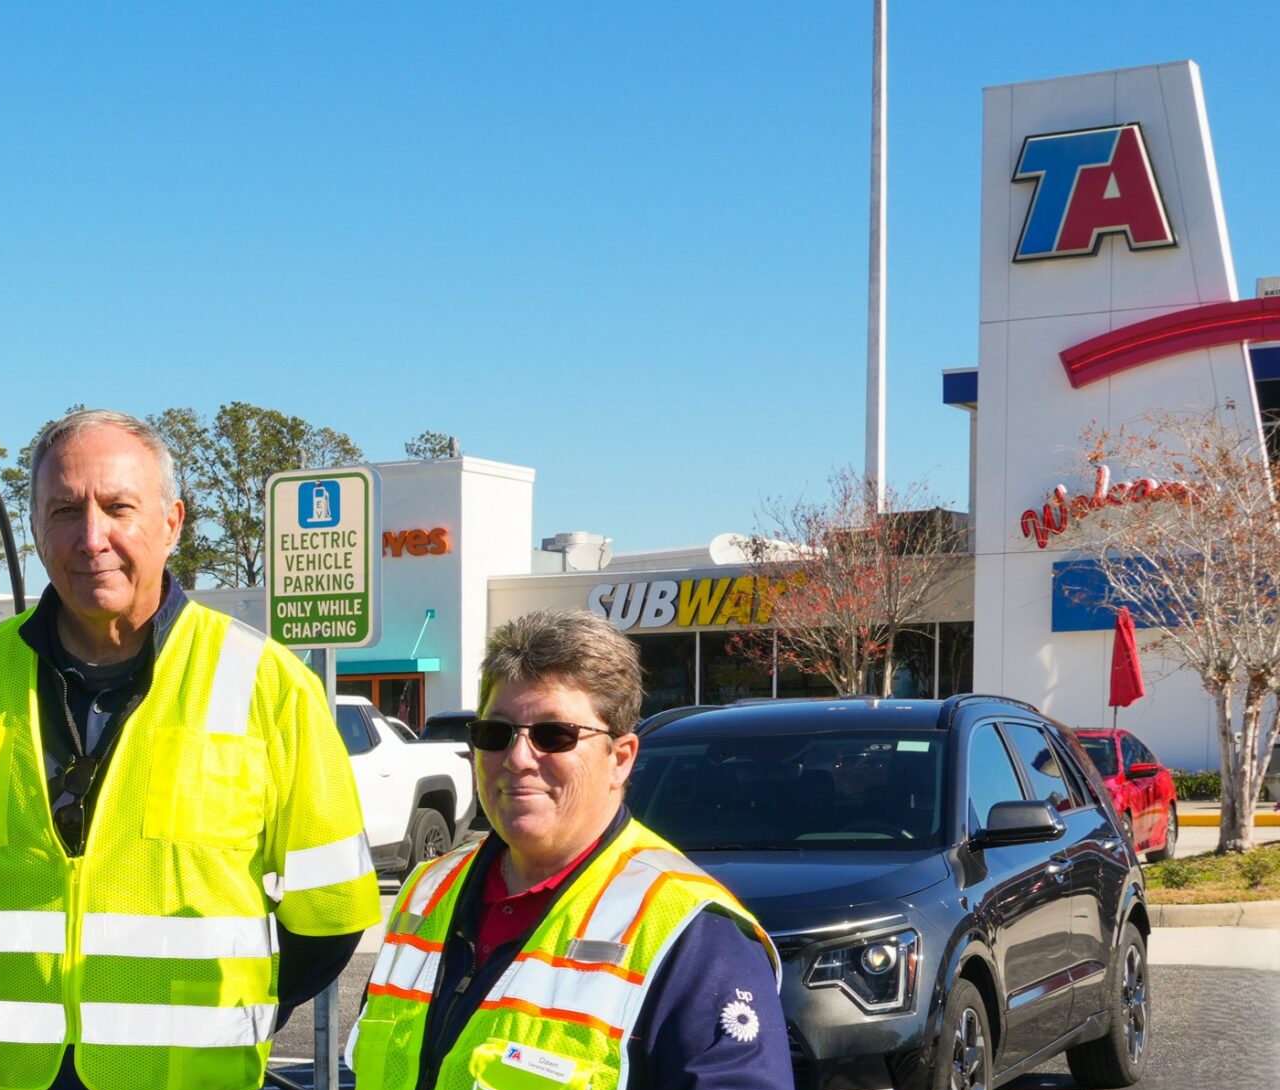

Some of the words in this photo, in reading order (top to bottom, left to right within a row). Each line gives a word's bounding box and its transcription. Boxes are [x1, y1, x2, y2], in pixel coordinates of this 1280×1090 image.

[1013, 123, 1176, 262] TA
[280, 530, 357, 551] ELECTRIC
[382, 527, 449, 558] yes
[285, 552, 352, 572] VEHICLE
[283, 573, 355, 593] PARKING
[276, 601, 313, 618] ONLY
[317, 599, 362, 616] WHILE
[735, 987, 753, 1003] bp
[508, 1048, 522, 1061] TA
[538, 1056, 559, 1069] Dawn
